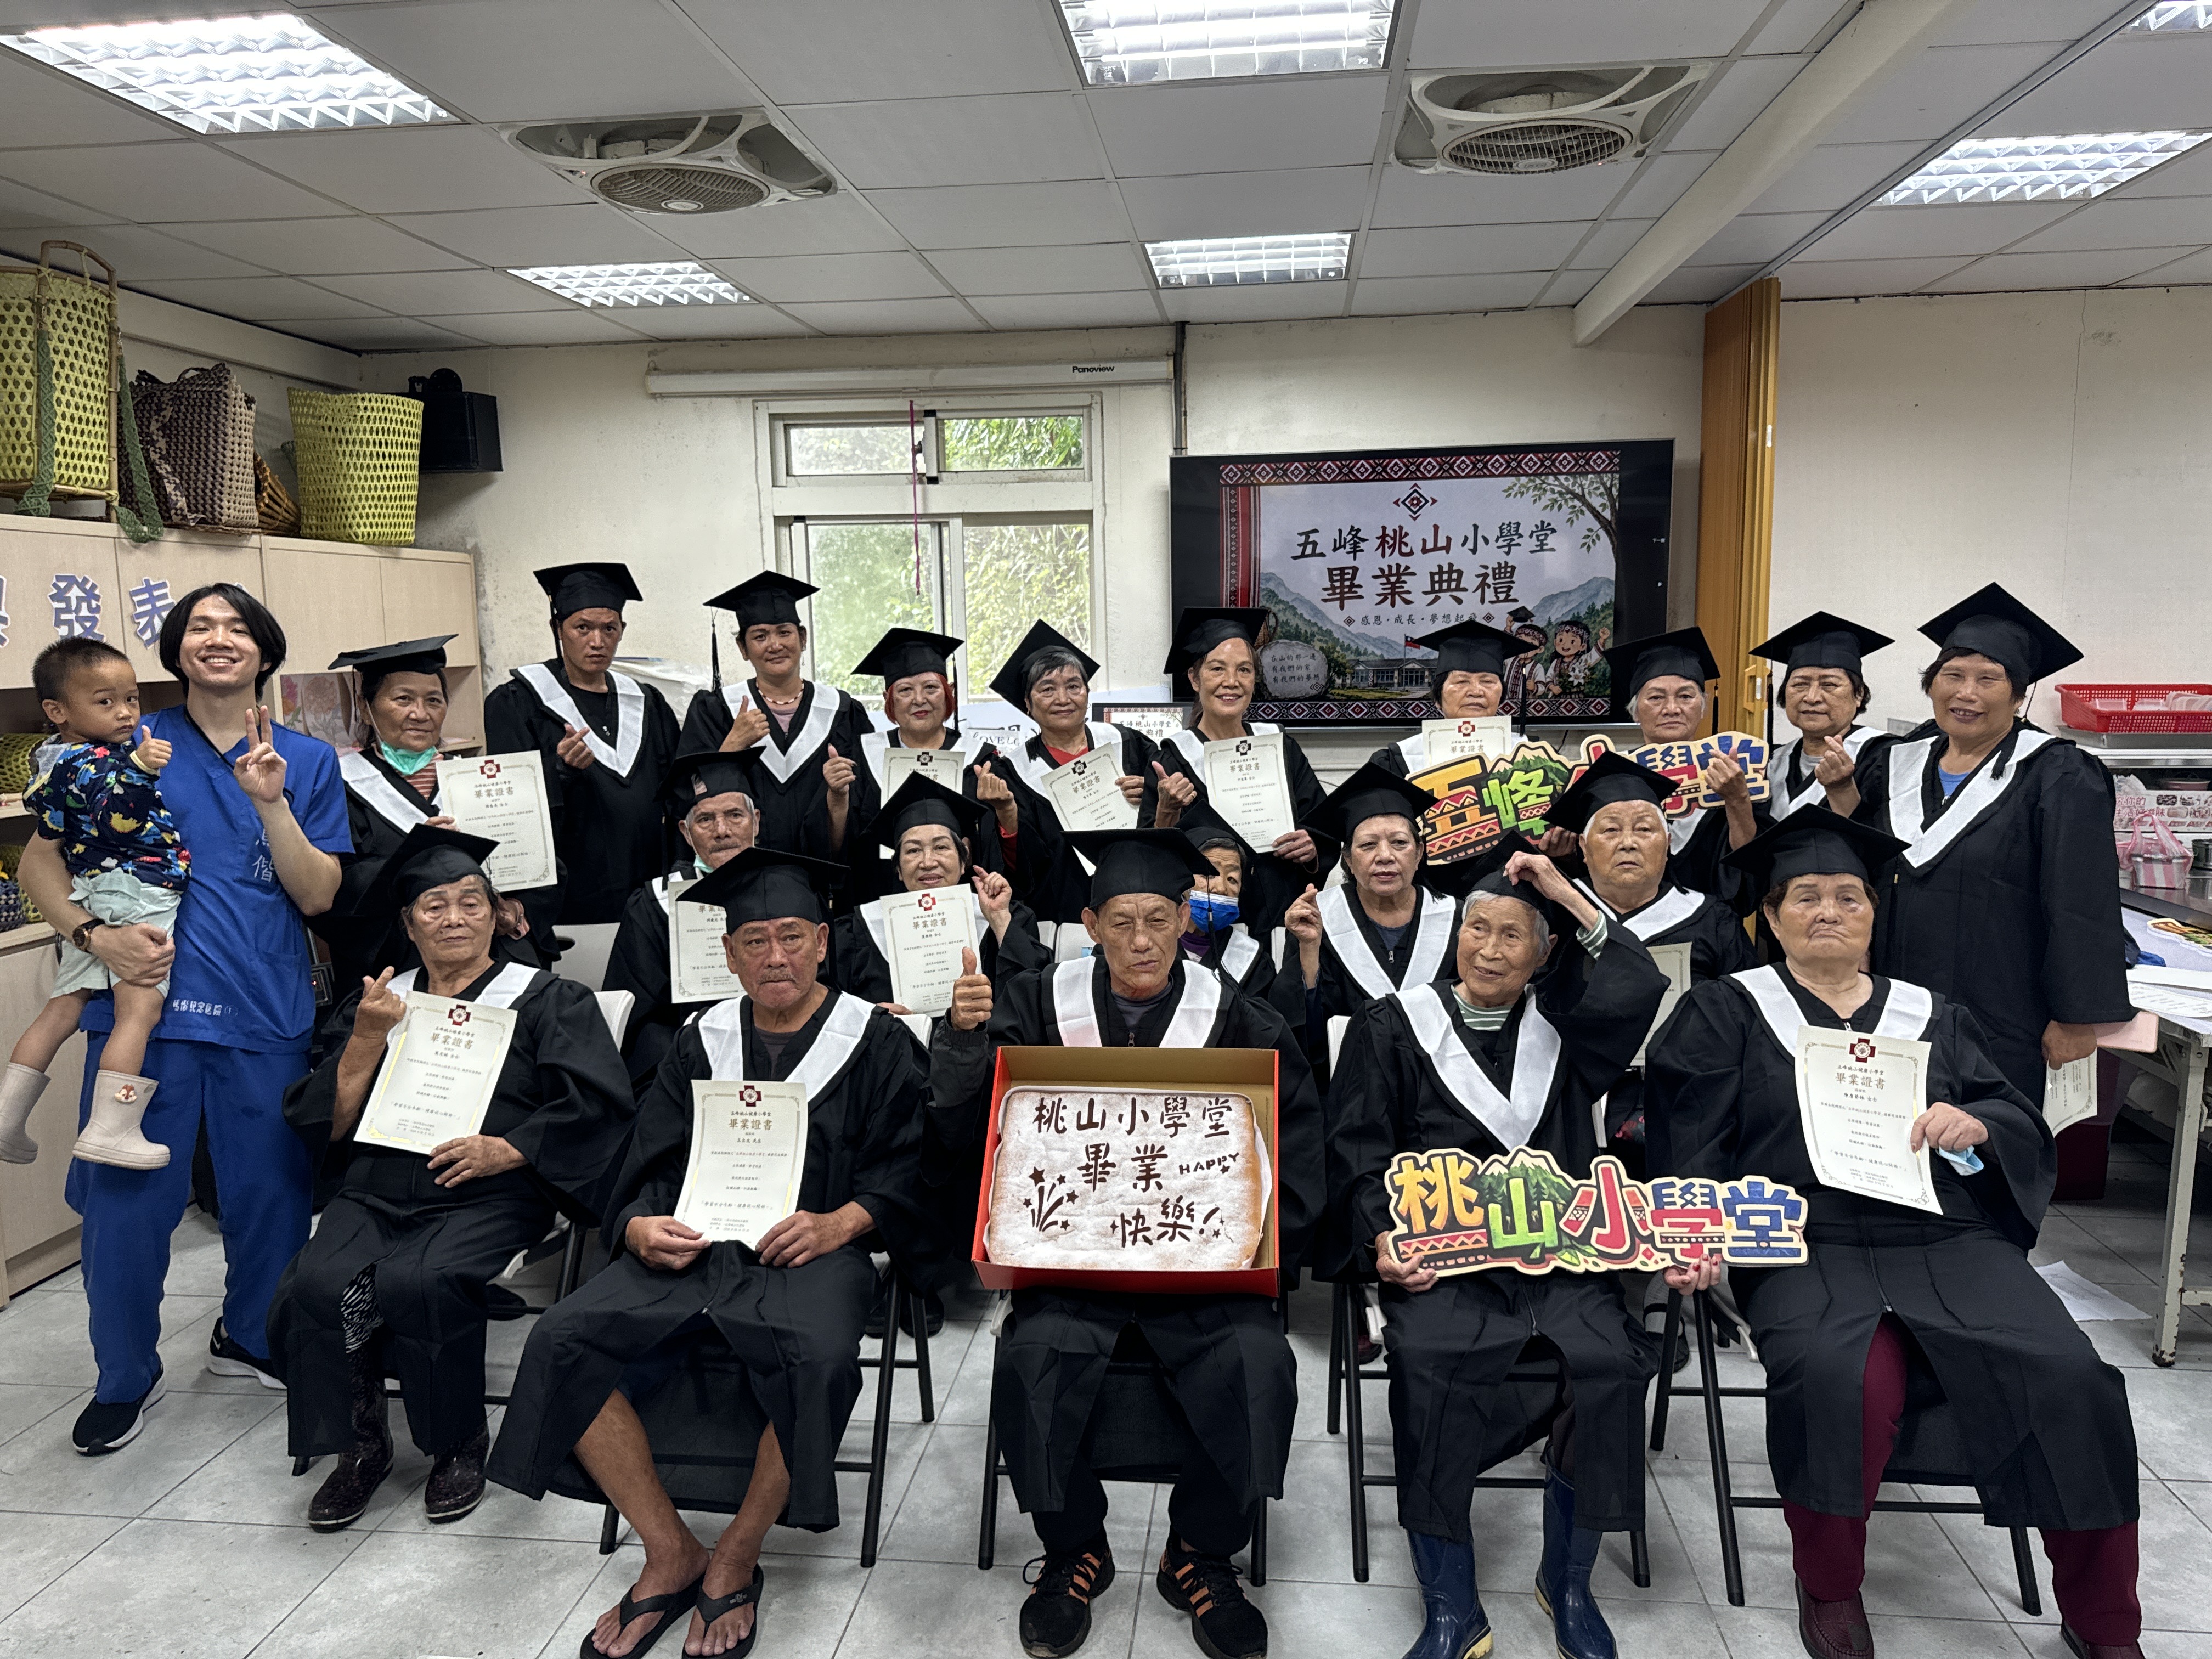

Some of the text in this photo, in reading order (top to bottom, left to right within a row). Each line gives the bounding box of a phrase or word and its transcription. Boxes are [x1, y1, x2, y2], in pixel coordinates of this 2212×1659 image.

[1072, 364, 1115, 373] Panoview
[1290, 520, 1558, 562] 五峰桃山小學堂
[1321, 561, 1520, 611] 畢業典禮
[0, 574, 177, 647] 發表
[1138, 729, 1164, 737] 典禮
[1835, 1072, 1886, 1090] 畢業證書
[729, 1118, 773, 1131] 畢業證書
[1033, 1096, 1232, 1138] 桃山小學堂
[1077, 1142, 1169, 1193] 畢業
[1178, 1153, 1239, 1175] HAPPY
[1120, 1195, 1220, 1248] 快樂!
[1396, 1155, 1803, 1260] 桃山小學堂
